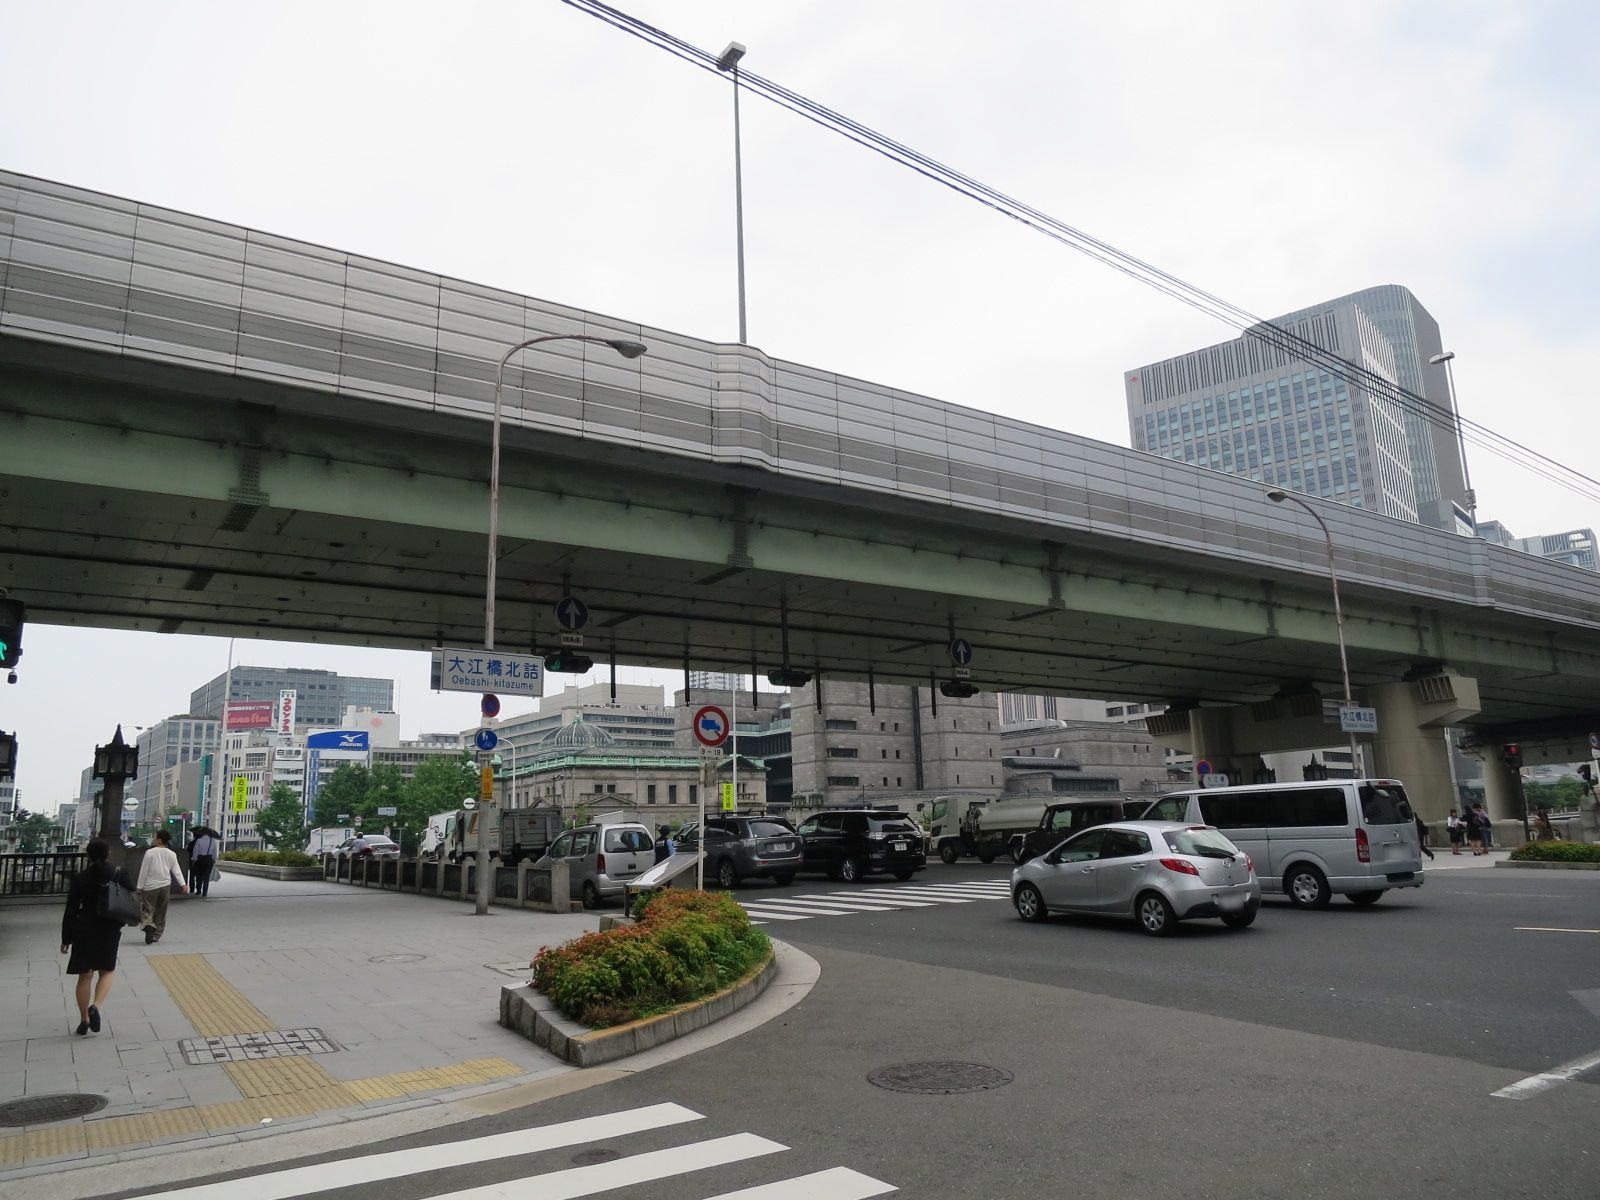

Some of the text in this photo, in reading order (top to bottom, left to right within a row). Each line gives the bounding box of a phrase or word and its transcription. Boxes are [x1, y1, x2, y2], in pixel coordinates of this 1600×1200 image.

[448, 656, 538, 679] 大江橋北詰
[451, 675, 534, 691] Oebashi-kitazume
